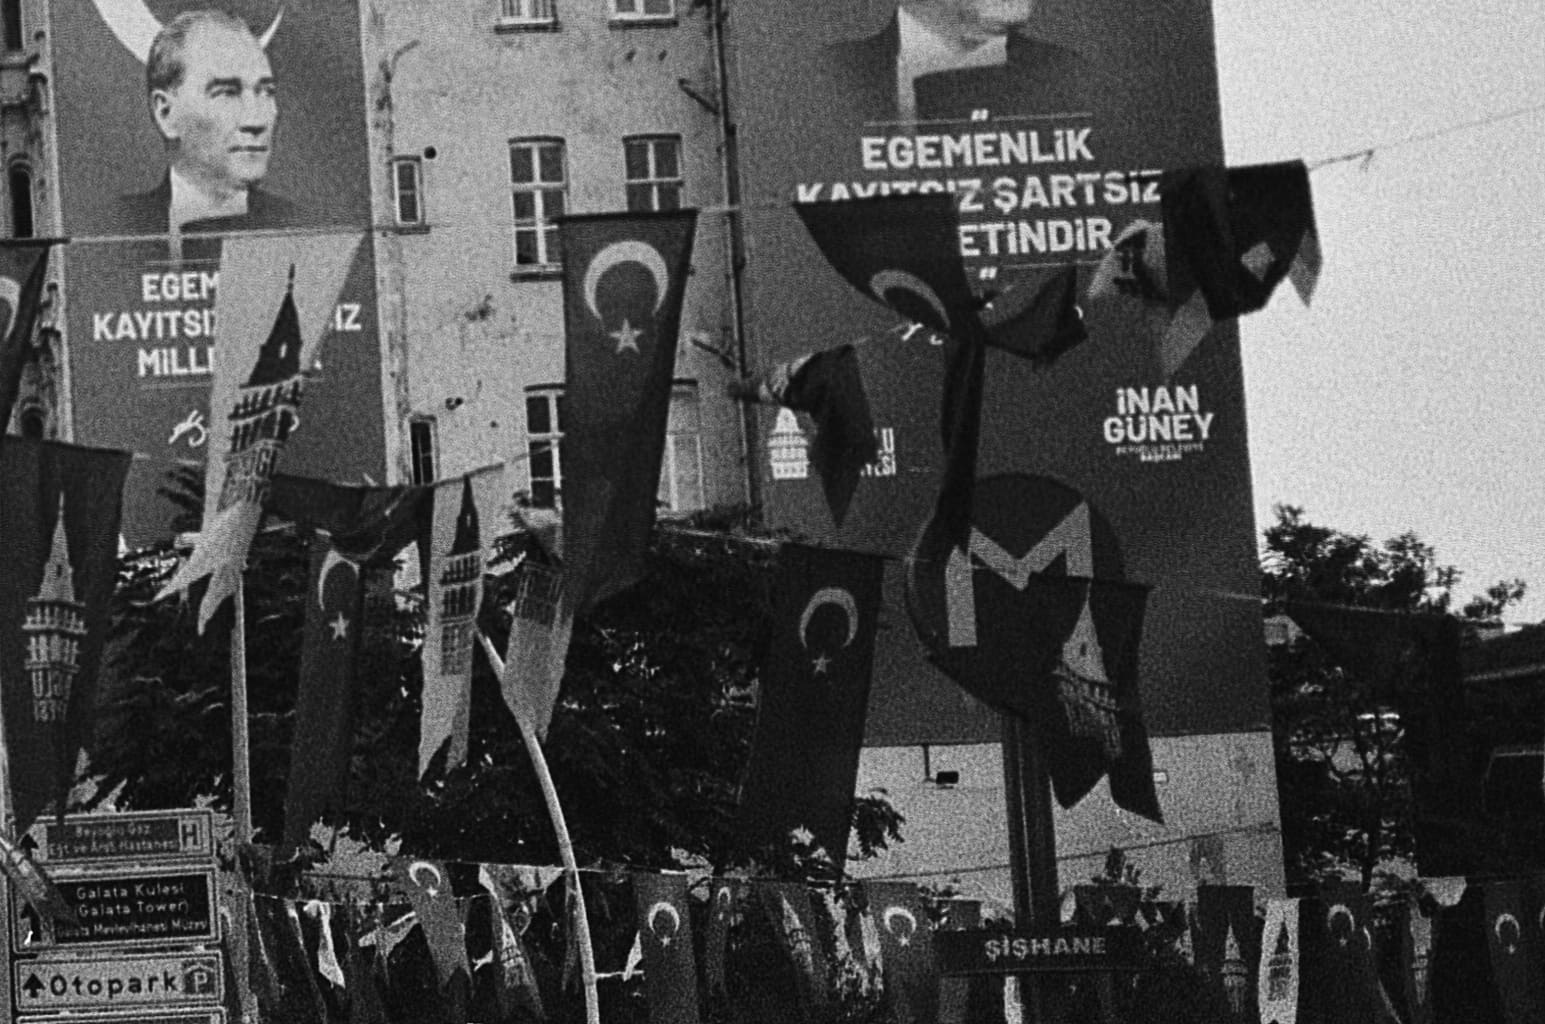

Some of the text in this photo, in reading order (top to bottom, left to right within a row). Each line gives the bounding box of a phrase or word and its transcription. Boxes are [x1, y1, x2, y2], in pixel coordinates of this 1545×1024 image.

[860, 126, 1095, 170] EGEMENLİK
[1116, 384, 1199, 415] İNAN
[1103, 412, 1215, 444] GÜNEY
[75, 881, 185, 900] Galata Kulesi
[984, 934, 1107, 963] ŞİŞHANE
[50, 970, 178, 1000] Otopark
